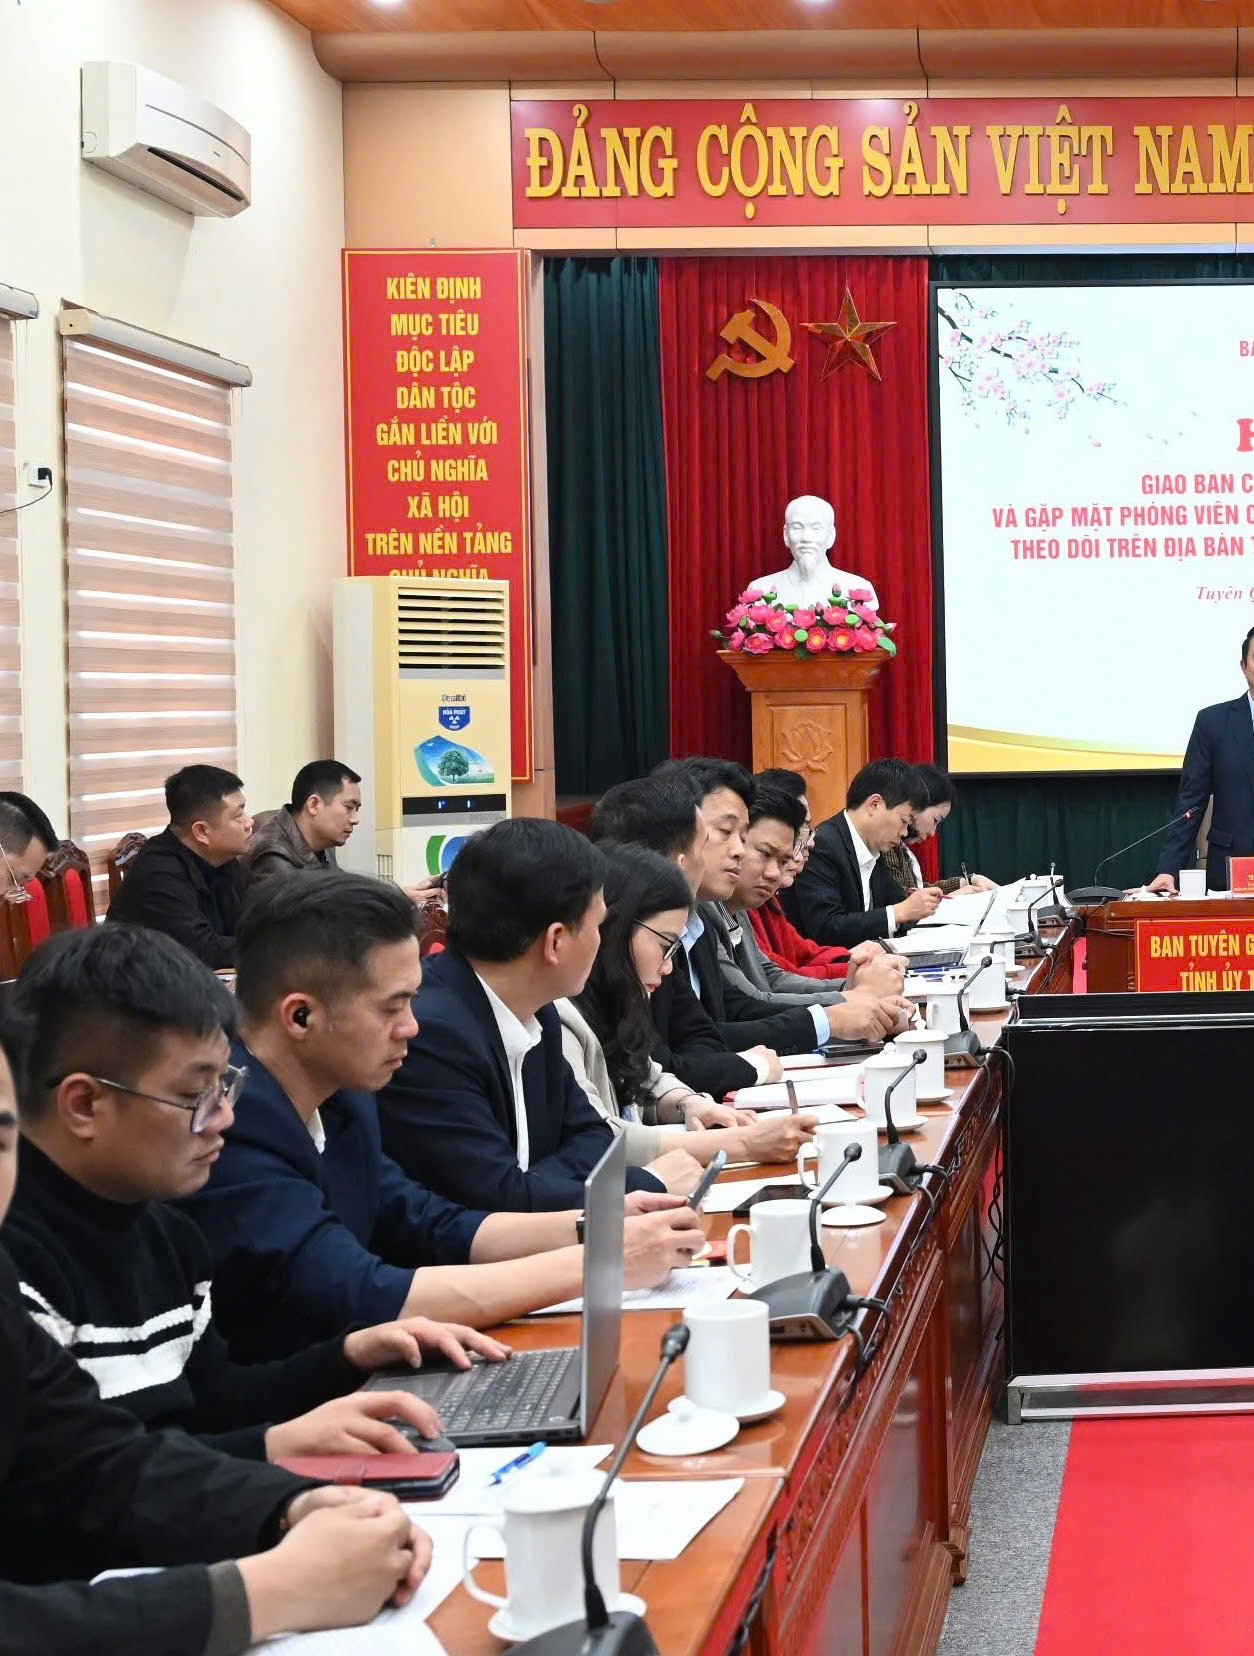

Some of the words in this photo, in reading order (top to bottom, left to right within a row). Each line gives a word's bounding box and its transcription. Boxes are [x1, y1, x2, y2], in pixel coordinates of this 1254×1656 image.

[525, 104, 678, 199] ĐẢNG
[696, 103, 844, 219] CỘNG
[862, 101, 971, 197] SẢN
[984, 105, 1112, 215] VIỆT
[1134, 125, 1254, 194] NAM
[387, 272, 431, 301] KIÊN
[436, 276, 481, 304] ĐỊNH
[391, 311, 433, 340] MỤC
[439, 308, 479, 336] TIÊU
[396, 343, 433, 377] ĐỘC
[440, 345, 474, 376] LẬP
[397, 381, 435, 409] DÂN
[441, 381, 476, 413] TỘC
[376, 415, 415, 446] GẮN
[421, 415, 462, 445] LIỀN
[467, 416, 497, 444] VỚI
[388, 450, 424, 482] CHỦ
[431, 456, 488, 481] NGHĨA
[1142, 474, 1187, 495] GIAO
[1194, 473, 1235, 494] BAN
[408, 492, 432, 518] XÃ
[438, 491, 469, 522] HỘI
[1194, 501, 1239, 526] VIÊN
[365, 528, 413, 555] TRÊN
[419, 522, 459, 555] NỀN
[463, 523, 512, 554] TẢNG
[1011, 538, 1060, 560] THEO
[1107, 534, 1157, 558] TRÊN
[1164, 536, 1197, 561] ĐỊA
[1197, 586, 1244, 603] Tuyên
[1151, 936, 1184, 957] BAN
[1189, 930, 1240, 956] TUYÊN
[1180, 962, 1219, 992] TỈNH
[1221, 962, 1242, 991] ỦY
